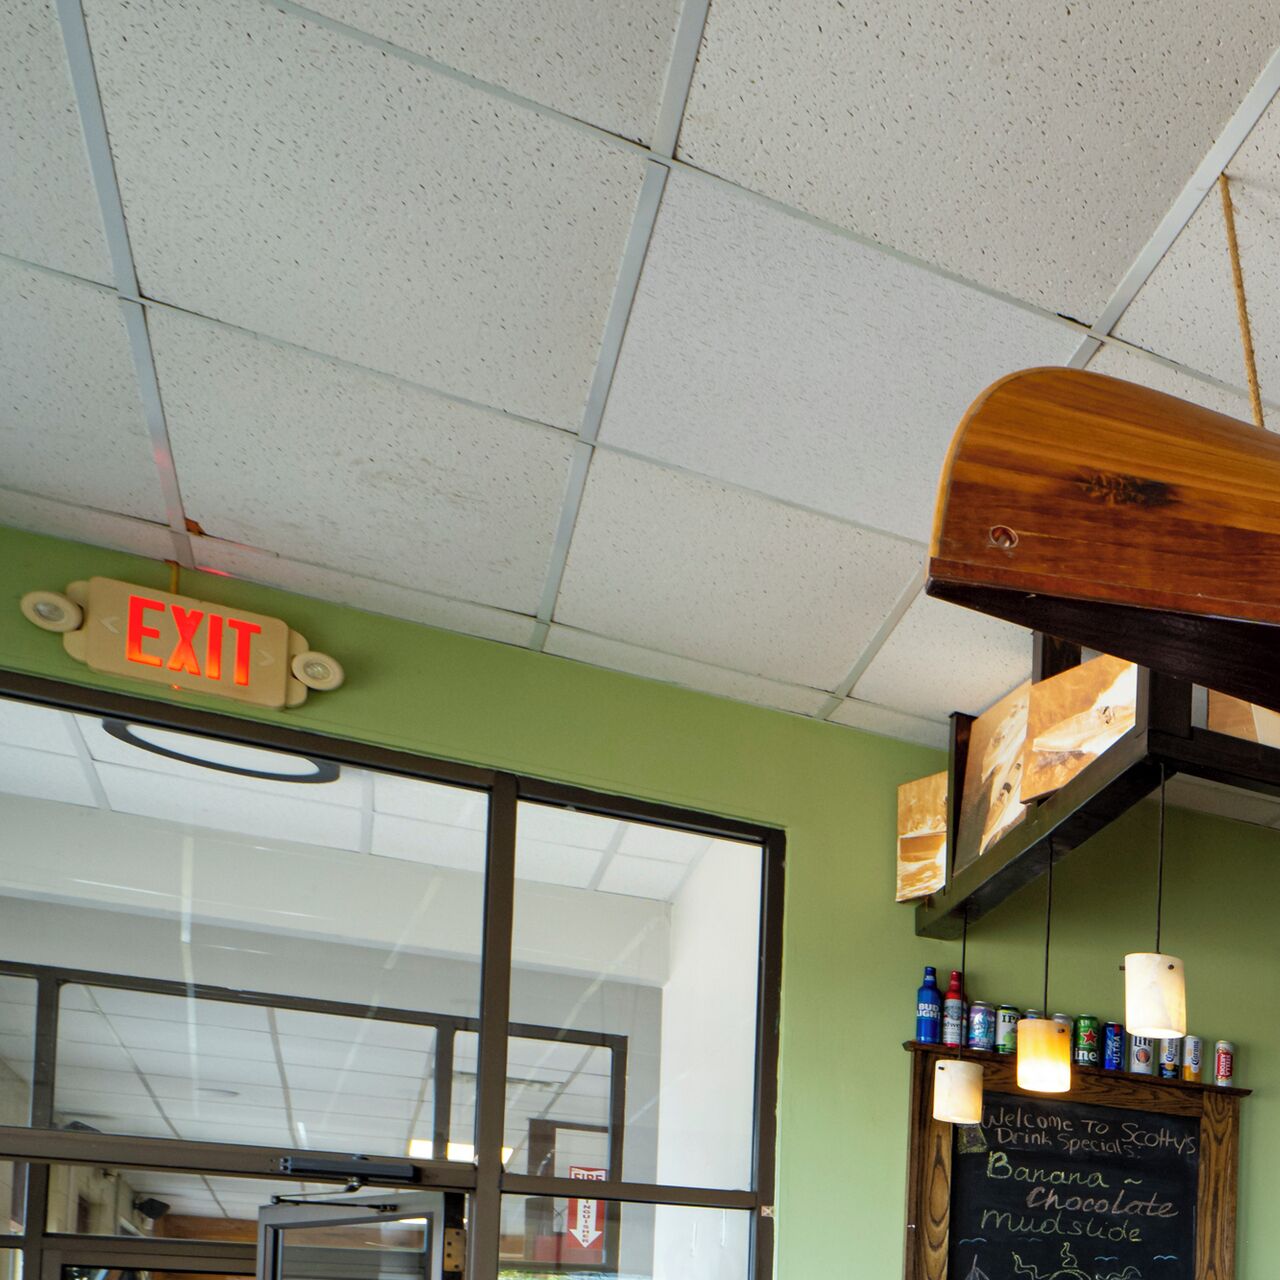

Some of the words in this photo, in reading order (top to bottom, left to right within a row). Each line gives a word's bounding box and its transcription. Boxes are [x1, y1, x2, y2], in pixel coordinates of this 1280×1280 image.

[126, 594, 262, 687] EXIT
[918, 1003, 939, 1011] BUD
[1112, 1036, 1121, 1063] ULTRA
[1192, 1040, 1200, 1066] Corona
[981, 1105, 1074, 1131] Welcome
[996, 1127, 1052, 1145] Drink
[986, 1150, 1110, 1188] Banana
[1026, 1186, 1179, 1218] Chocolate
